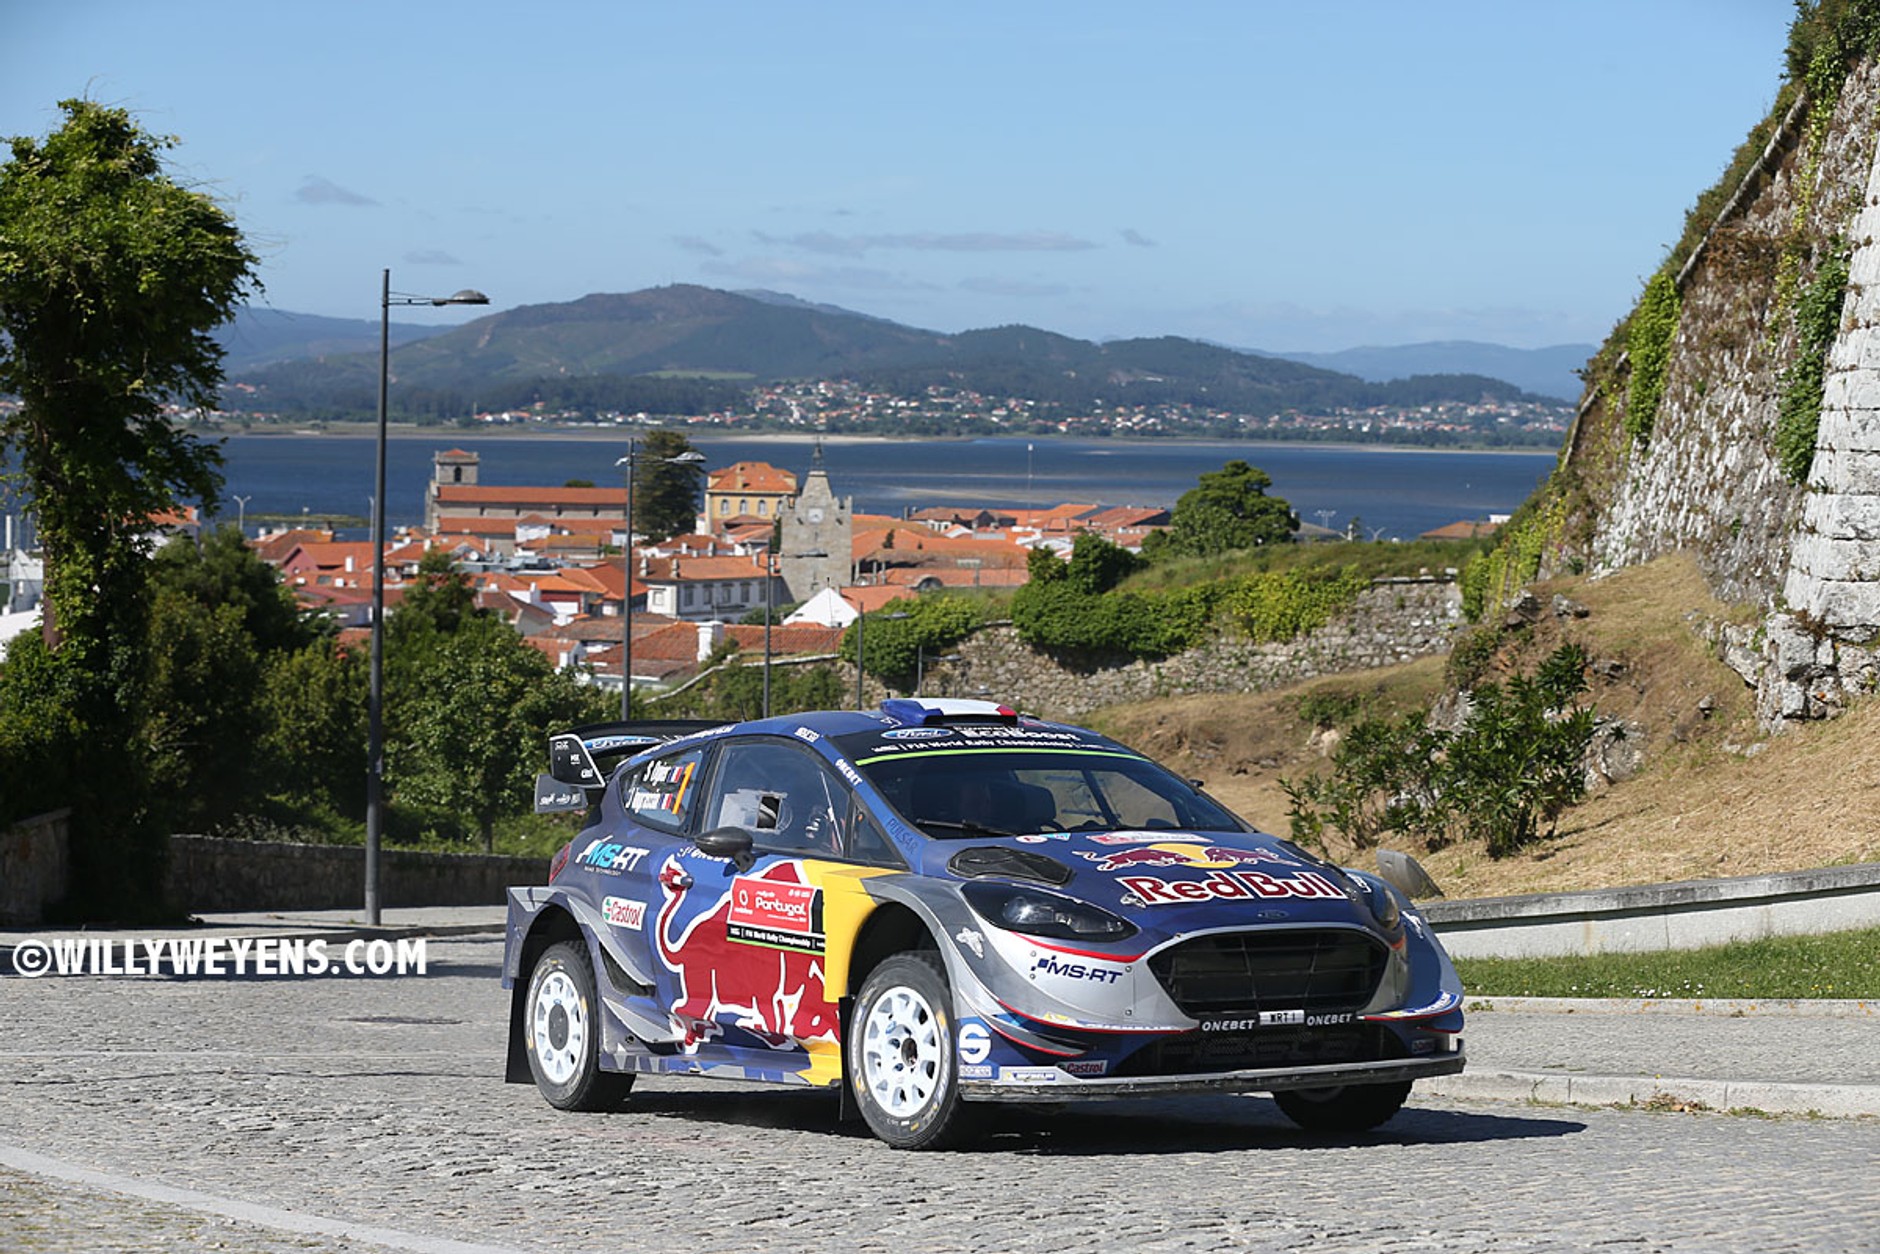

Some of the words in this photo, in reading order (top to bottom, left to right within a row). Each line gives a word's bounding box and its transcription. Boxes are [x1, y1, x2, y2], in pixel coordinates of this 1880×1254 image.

[886, 818, 918, 855] PULSAR
[1120, 873, 1249, 903] Red
[1247, 871, 1345, 900] Bull
[610, 901, 642, 926] Castrol
[755, 896, 807, 917] Portugal
[1201, 1019, 1256, 1032] ONEBET
[1307, 1013, 1353, 1026] ONEBET
[1066, 1062, 1105, 1074] Castrol
